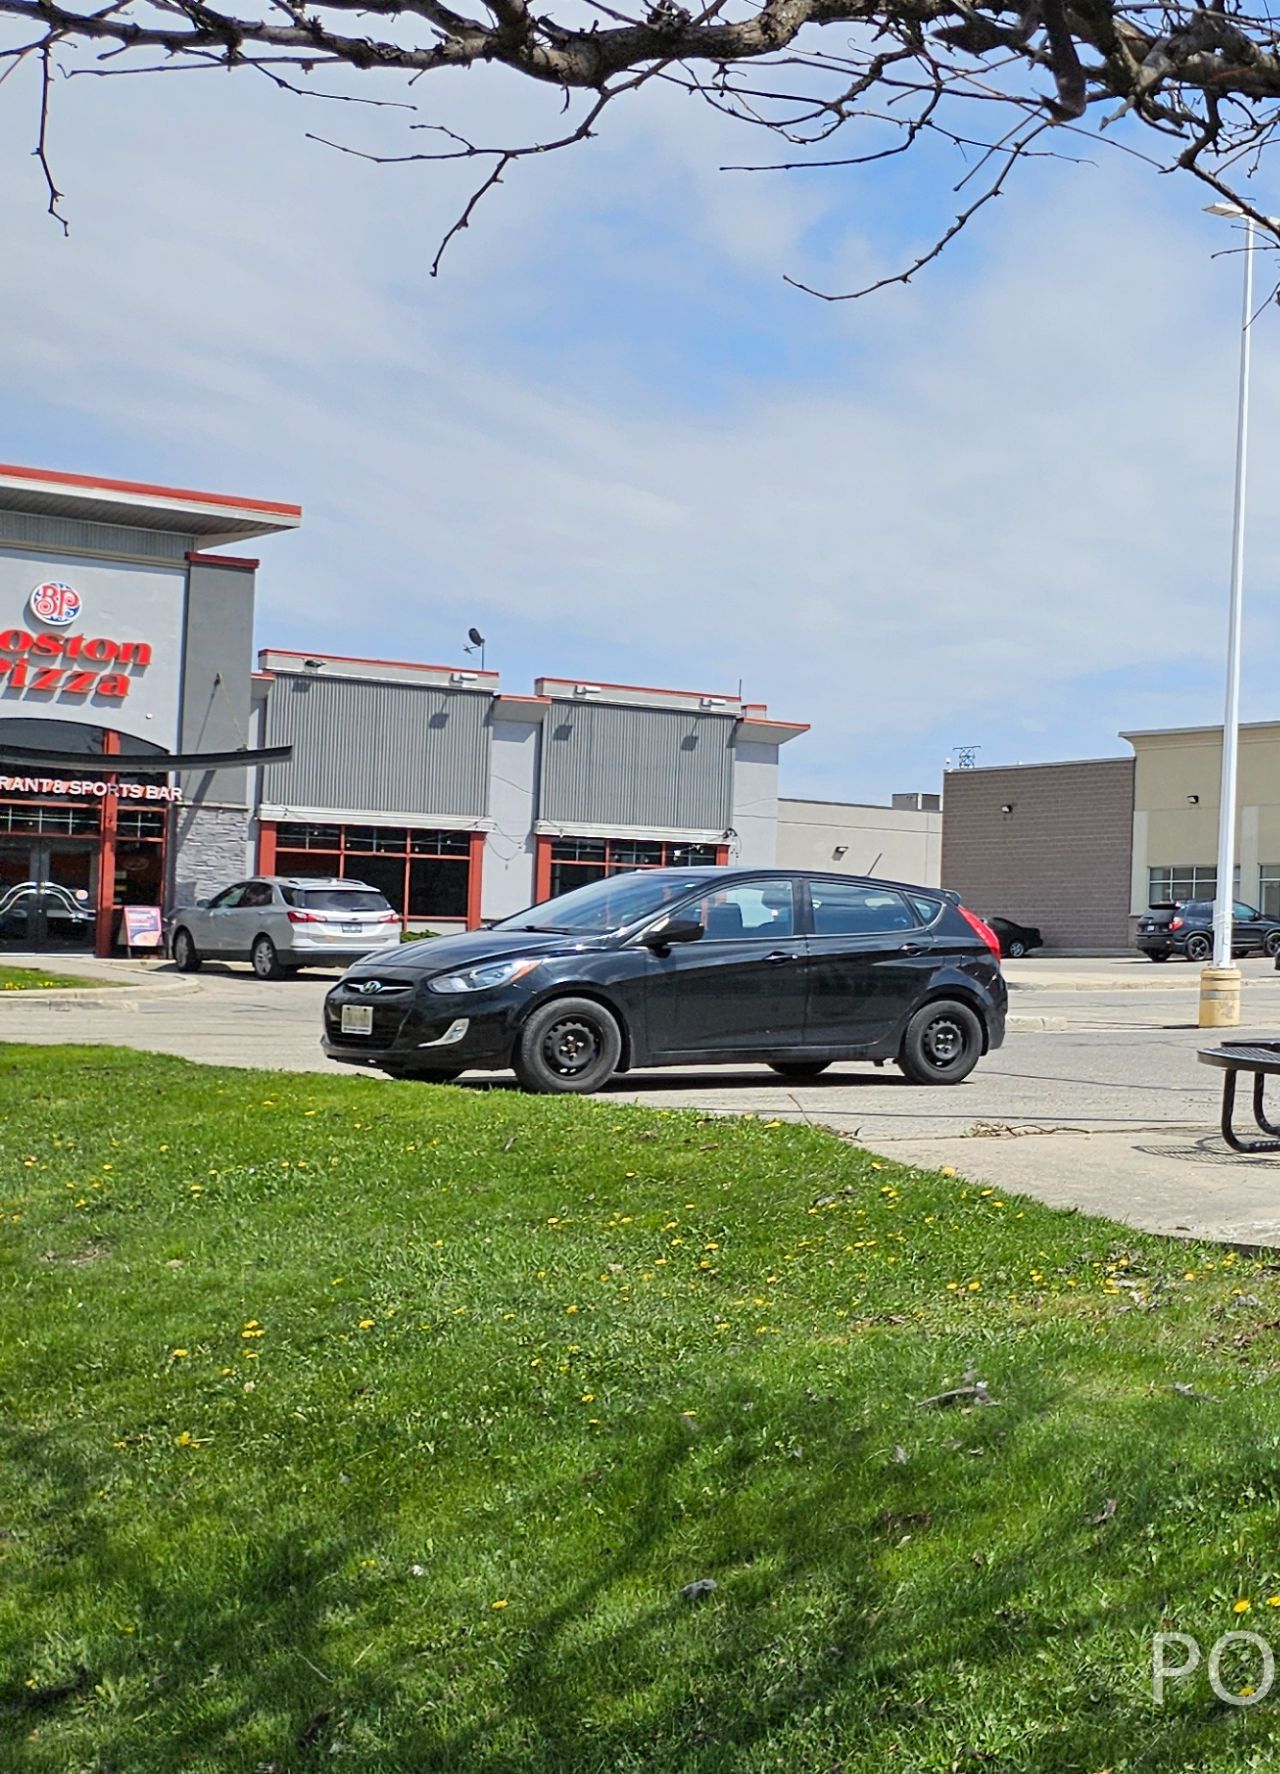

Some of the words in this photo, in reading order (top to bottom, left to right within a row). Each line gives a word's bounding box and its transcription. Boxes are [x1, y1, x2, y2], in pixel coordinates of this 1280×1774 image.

[36, 584, 80, 617] BP
[69, 780, 143, 799] SPORTS
[145, 787, 182, 801] BAR
